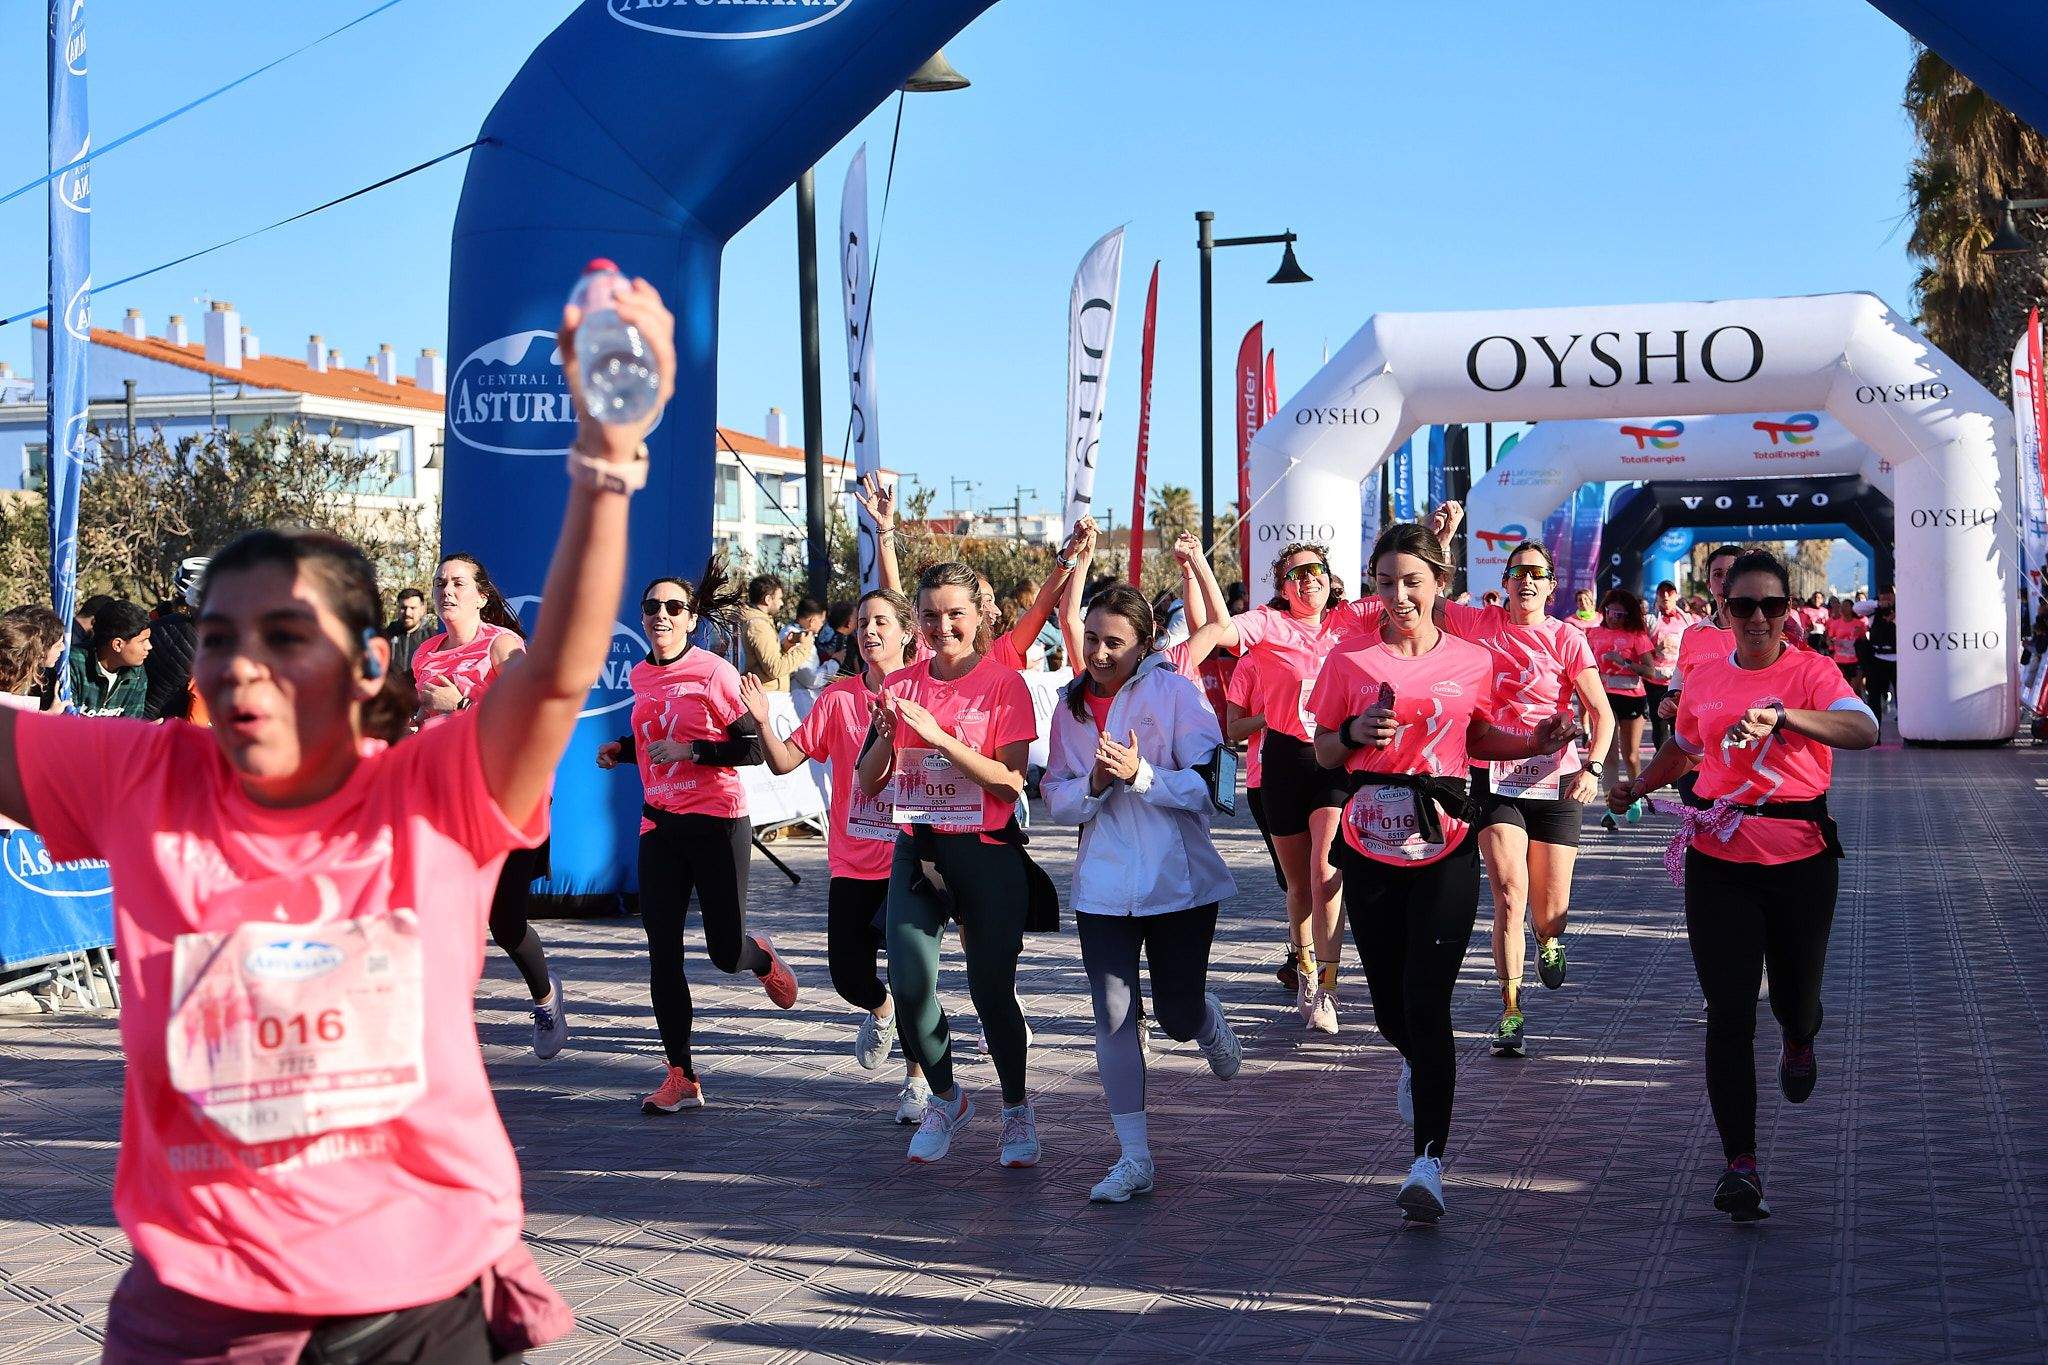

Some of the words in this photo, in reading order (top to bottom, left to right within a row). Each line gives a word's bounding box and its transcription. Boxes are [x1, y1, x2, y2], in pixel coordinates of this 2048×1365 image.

[1466, 326, 1764, 392] OYSHO
[478, 374, 548, 386] CENTRAL
[455, 378, 581, 424] ASTURI
[1855, 382, 1950, 404] OYSHO
[1296, 407, 1380, 426] OYSHO
[1620, 455, 1686, 466] TotalEnergies
[1753, 450, 1820, 463] TotalEnergies
[1681, 492, 1830, 511] VOLVO
[1911, 506, 1997, 528] OYSHO
[1258, 524, 1335, 542] OYSHO
[1912, 631, 1999, 651] OYSHO
[1514, 765, 1540, 776] 016
[926, 783, 956, 796] 016
[876, 801, 894, 814] 01
[1381, 815, 1415, 830] 016
[258, 1009, 345, 1050] 016
